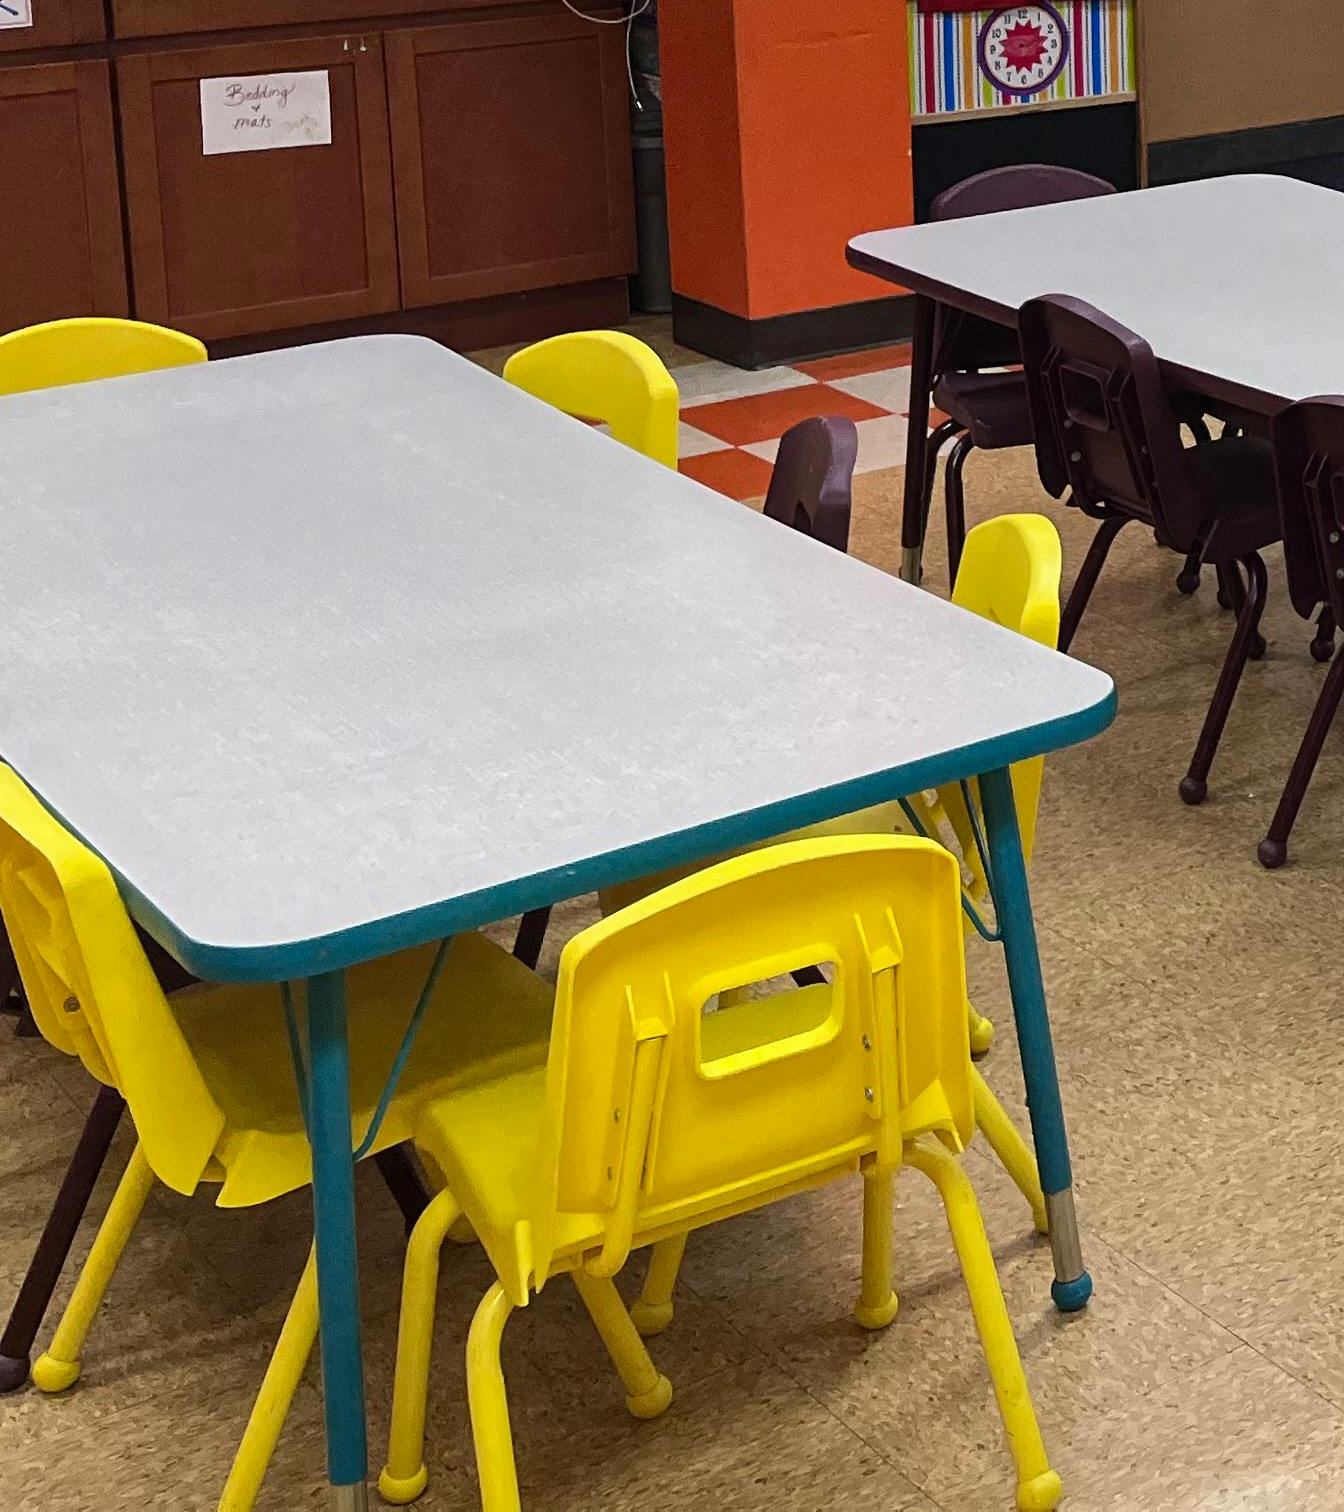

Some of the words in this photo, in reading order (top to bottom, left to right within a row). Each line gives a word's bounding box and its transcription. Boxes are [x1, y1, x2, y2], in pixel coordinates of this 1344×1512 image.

[1004, 14, 1011, 25] 11
[1018, 9, 1027, 19] 12
[991, 28, 1002, 39] 10
[1047, 23, 1054, 34] 2
[989, 44, 996, 55] 9
[1051, 39, 1058, 49] 3
[994, 60, 1001, 70] 8
[1047, 56, 1053, 66] 4
[1006, 71, 1012, 82] 7
[1021, 74, 1027, 85] 6
[232, 114, 272, 130] mats
